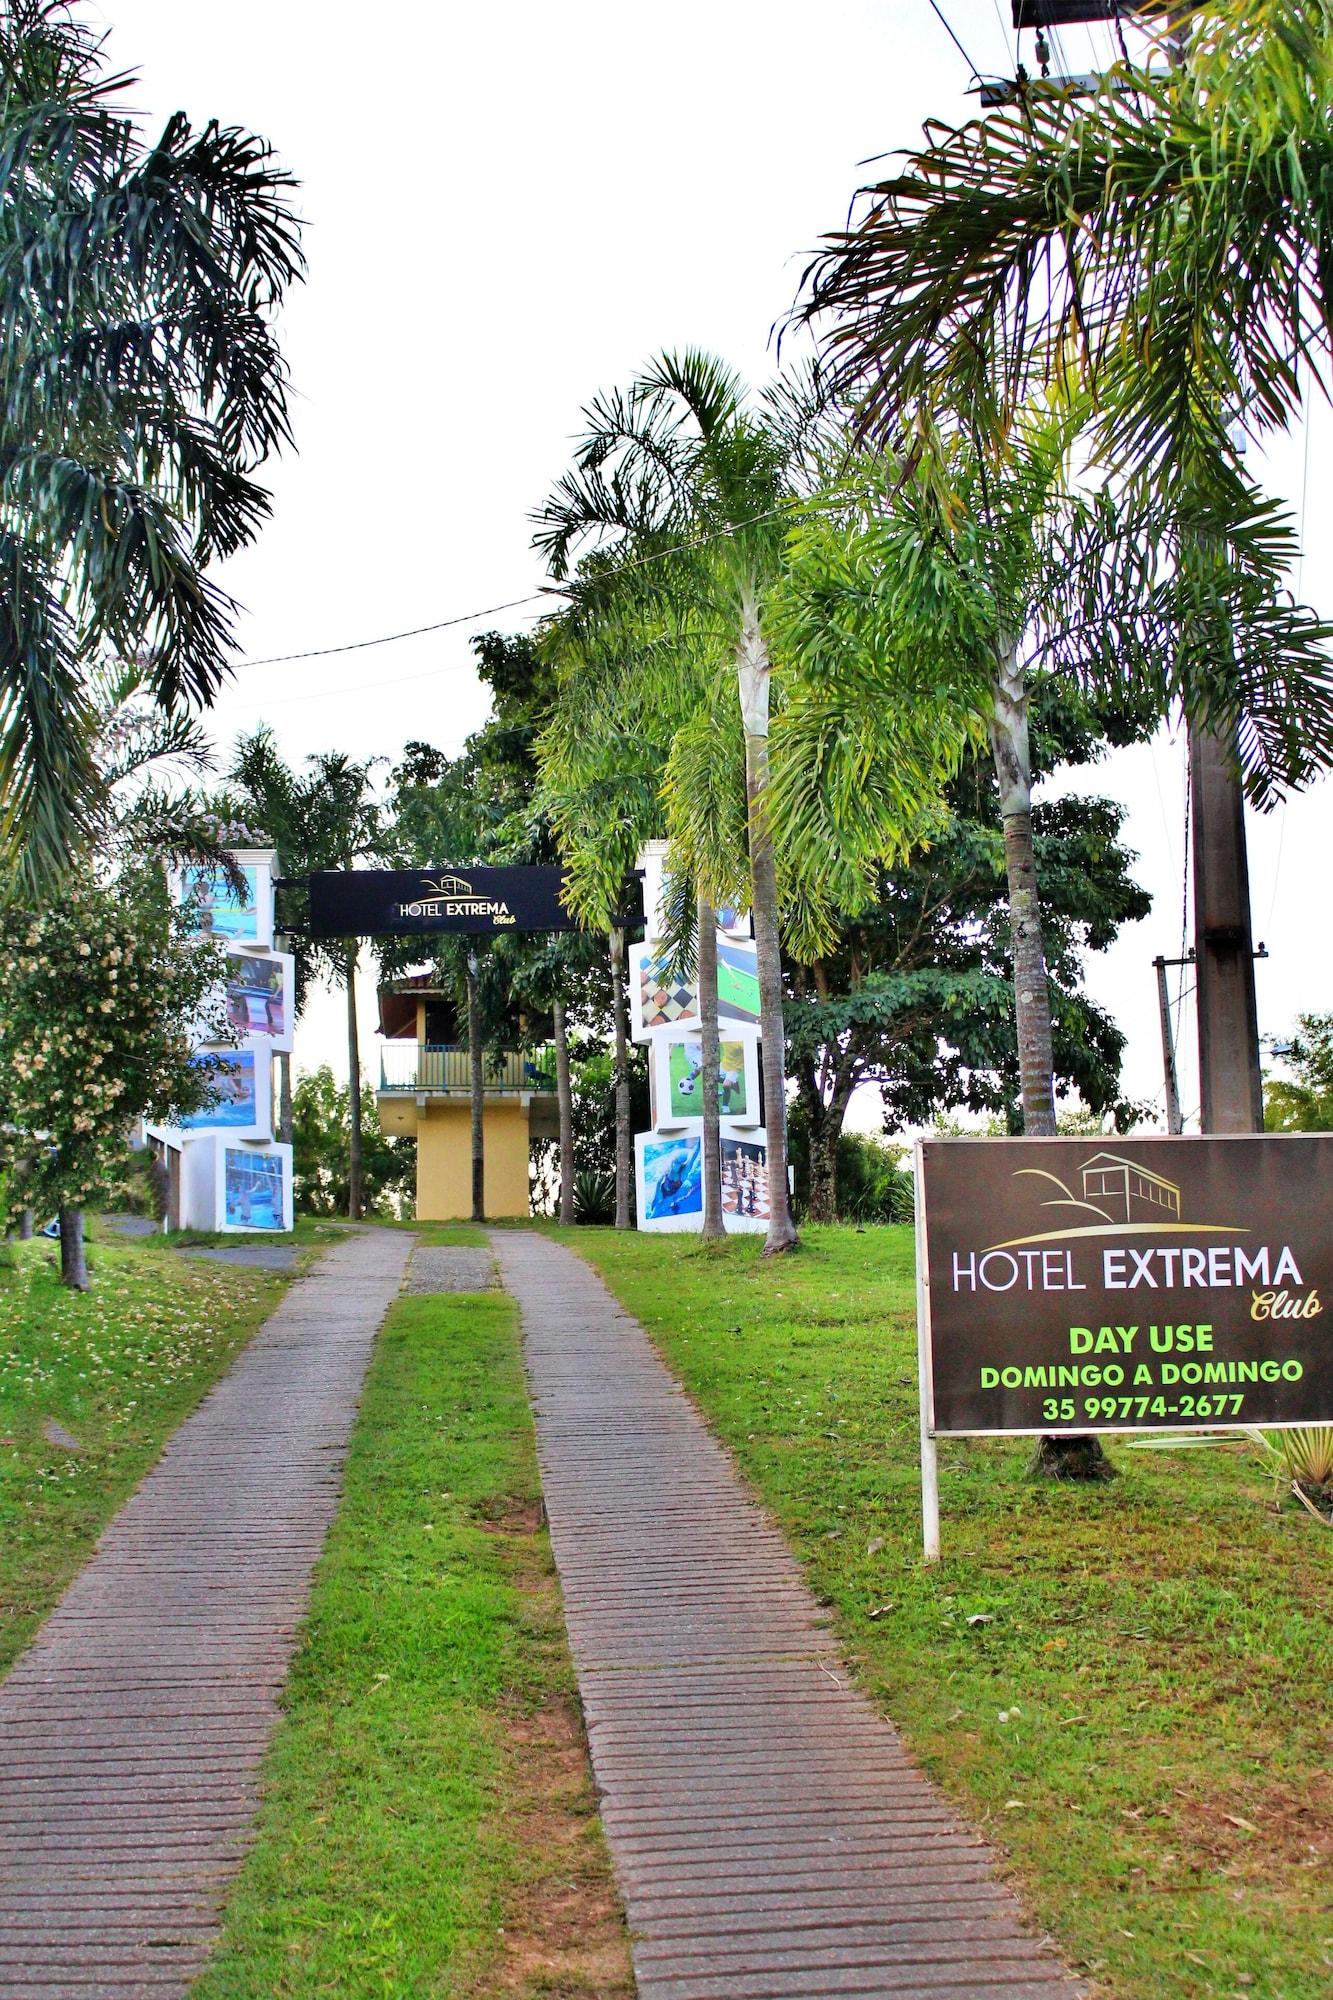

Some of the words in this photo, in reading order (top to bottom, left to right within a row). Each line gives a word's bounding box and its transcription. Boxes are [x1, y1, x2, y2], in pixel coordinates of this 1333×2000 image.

[400, 904, 442, 917] HOTEL
[447, 902, 509, 916] EXTREMA
[493, 915, 516, 925] Club
[952, 1250, 1087, 1292] HOTEL
[1103, 1246, 1304, 1290] EXTREMA
[1250, 1289, 1323, 1322] Club
[1069, 1326, 1139, 1355] DAY
[1149, 1324, 1214, 1354] USE
[980, 1364, 1124, 1389] DOMINGO
[1133, 1363, 1153, 1385] A
[1161, 1360, 1304, 1386] DOMINGO
[1042, 1398, 1076, 1421] 35
[1084, 1394, 1245, 1420] 99774-2677
